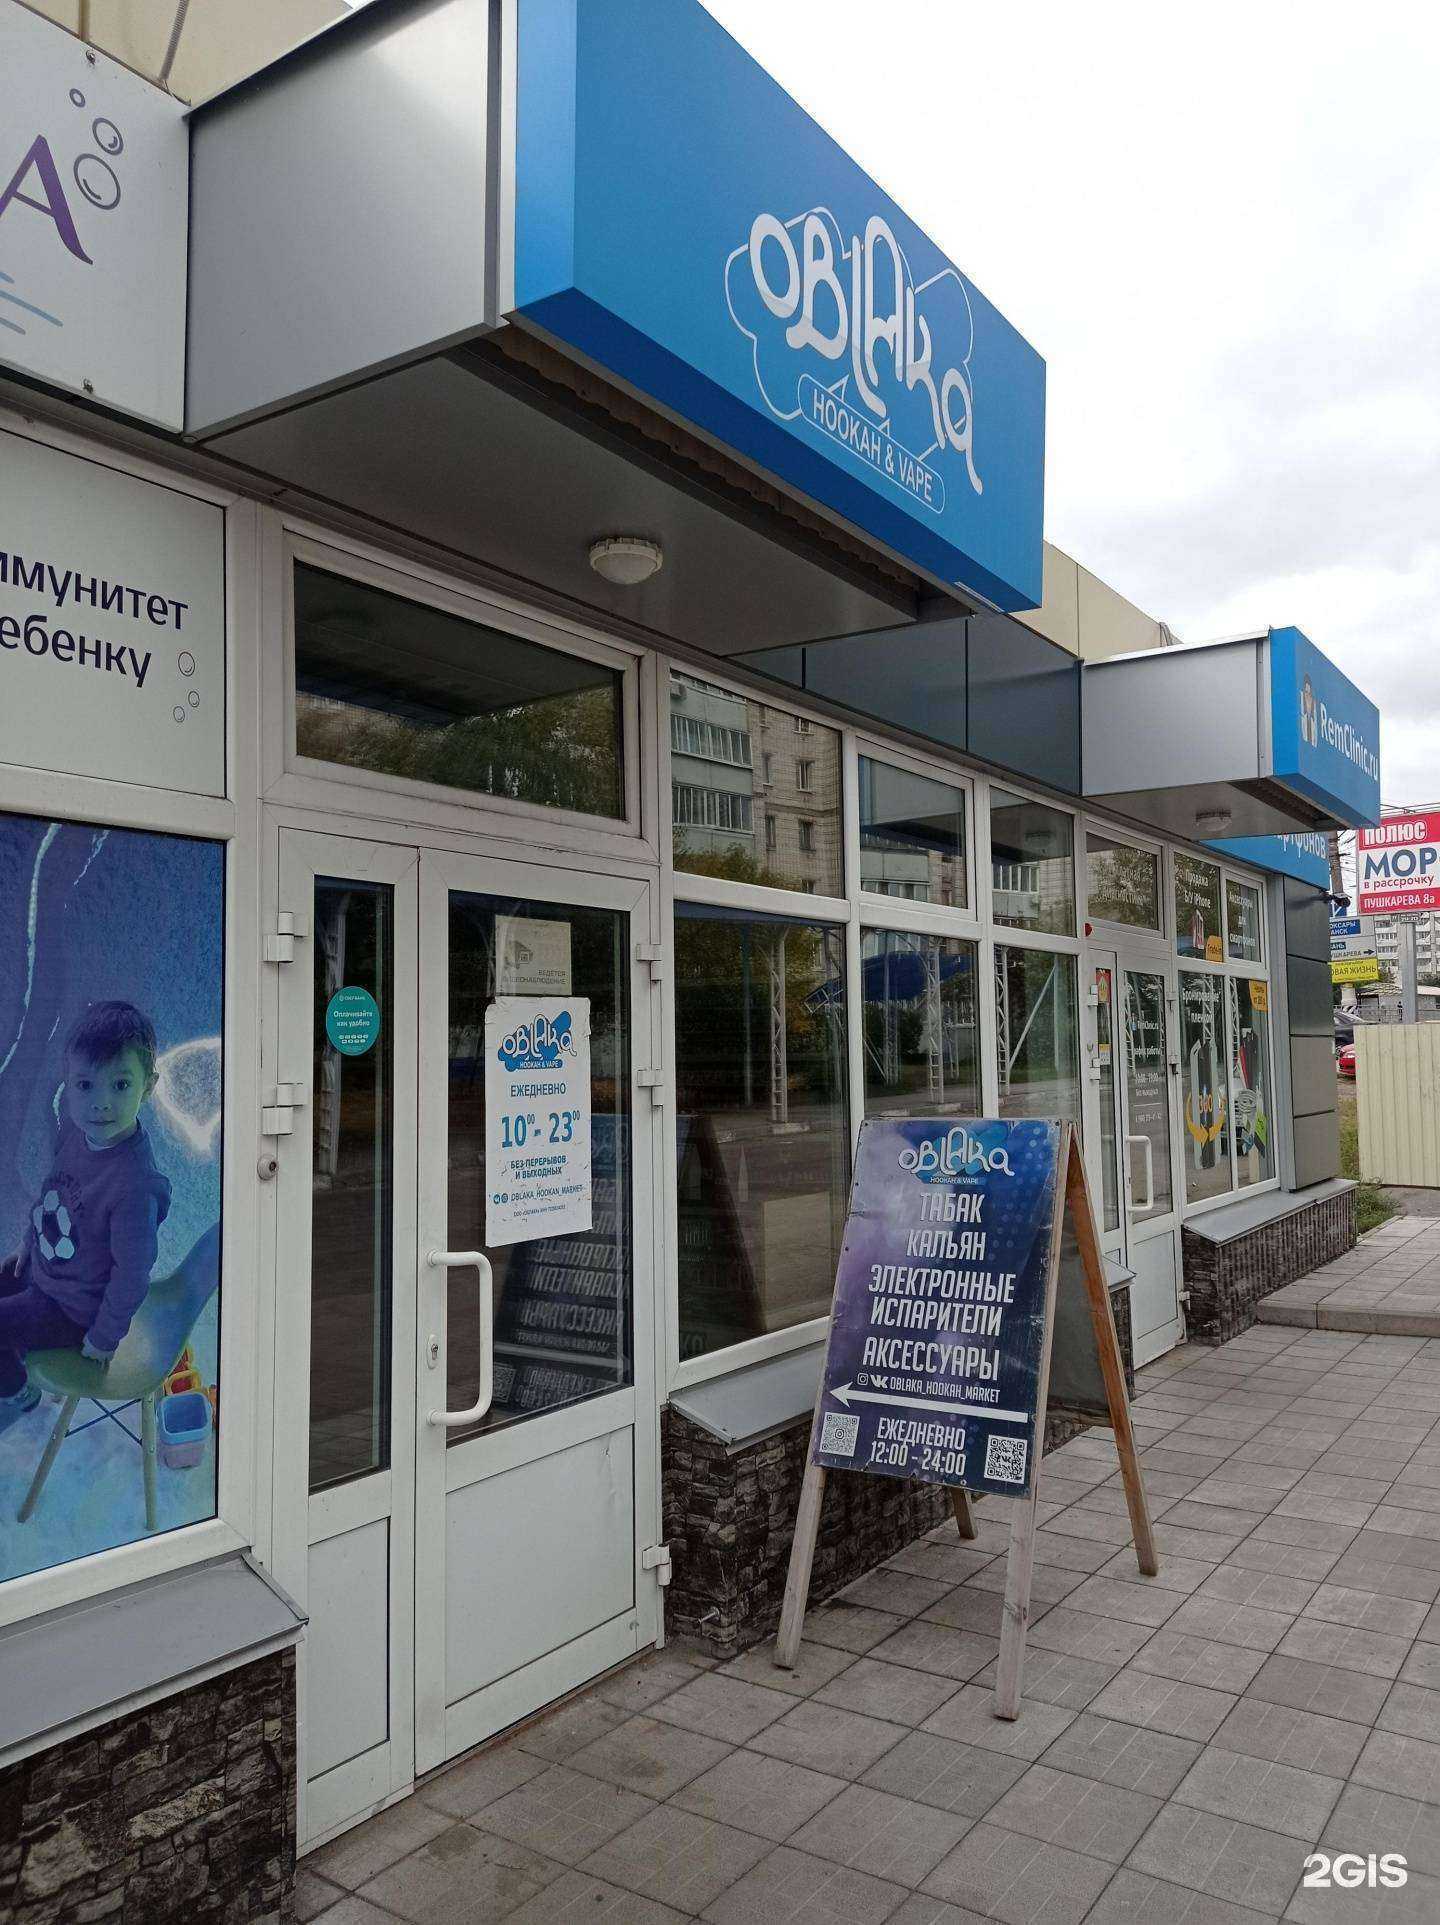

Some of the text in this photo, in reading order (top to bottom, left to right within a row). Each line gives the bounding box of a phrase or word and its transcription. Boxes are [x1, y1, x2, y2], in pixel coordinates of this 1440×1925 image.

[812, 387, 934, 503] HOOKAH & VAPE
[1320, 702, 1378, 781] RemClinic.ru
[1364, 821, 1426, 846] ПОЛЮС
[1364, 875, 1435, 891] в рассрочку
[1364, 893, 1421, 908] ПУШКАРЕВА
[510, 1082, 567, 1098] ЕЖЕДНЕВНО
[522, 1167, 562, 1179] ВЫХОДНЫХ
[526, 1155, 567, 1167] ПЕРЕРЫВОВ
[920, 1191, 985, 1223] ТАБАК
[906, 1229, 986, 1261] КАЛЬЯН
[868, 1263, 1016, 1303] ЭЛЕКТРОННЫЕ
[869, 1296, 1003, 1337] ИСПАРИТЕЛИ
[862, 1336, 1000, 1381] АКСЕССУАРЫ
[877, 1417, 966, 1450] ЕЖЕДНЕВНО
[870, 1440, 908, 1467] 12:00
[922, 1449, 966, 1476] 24:00
